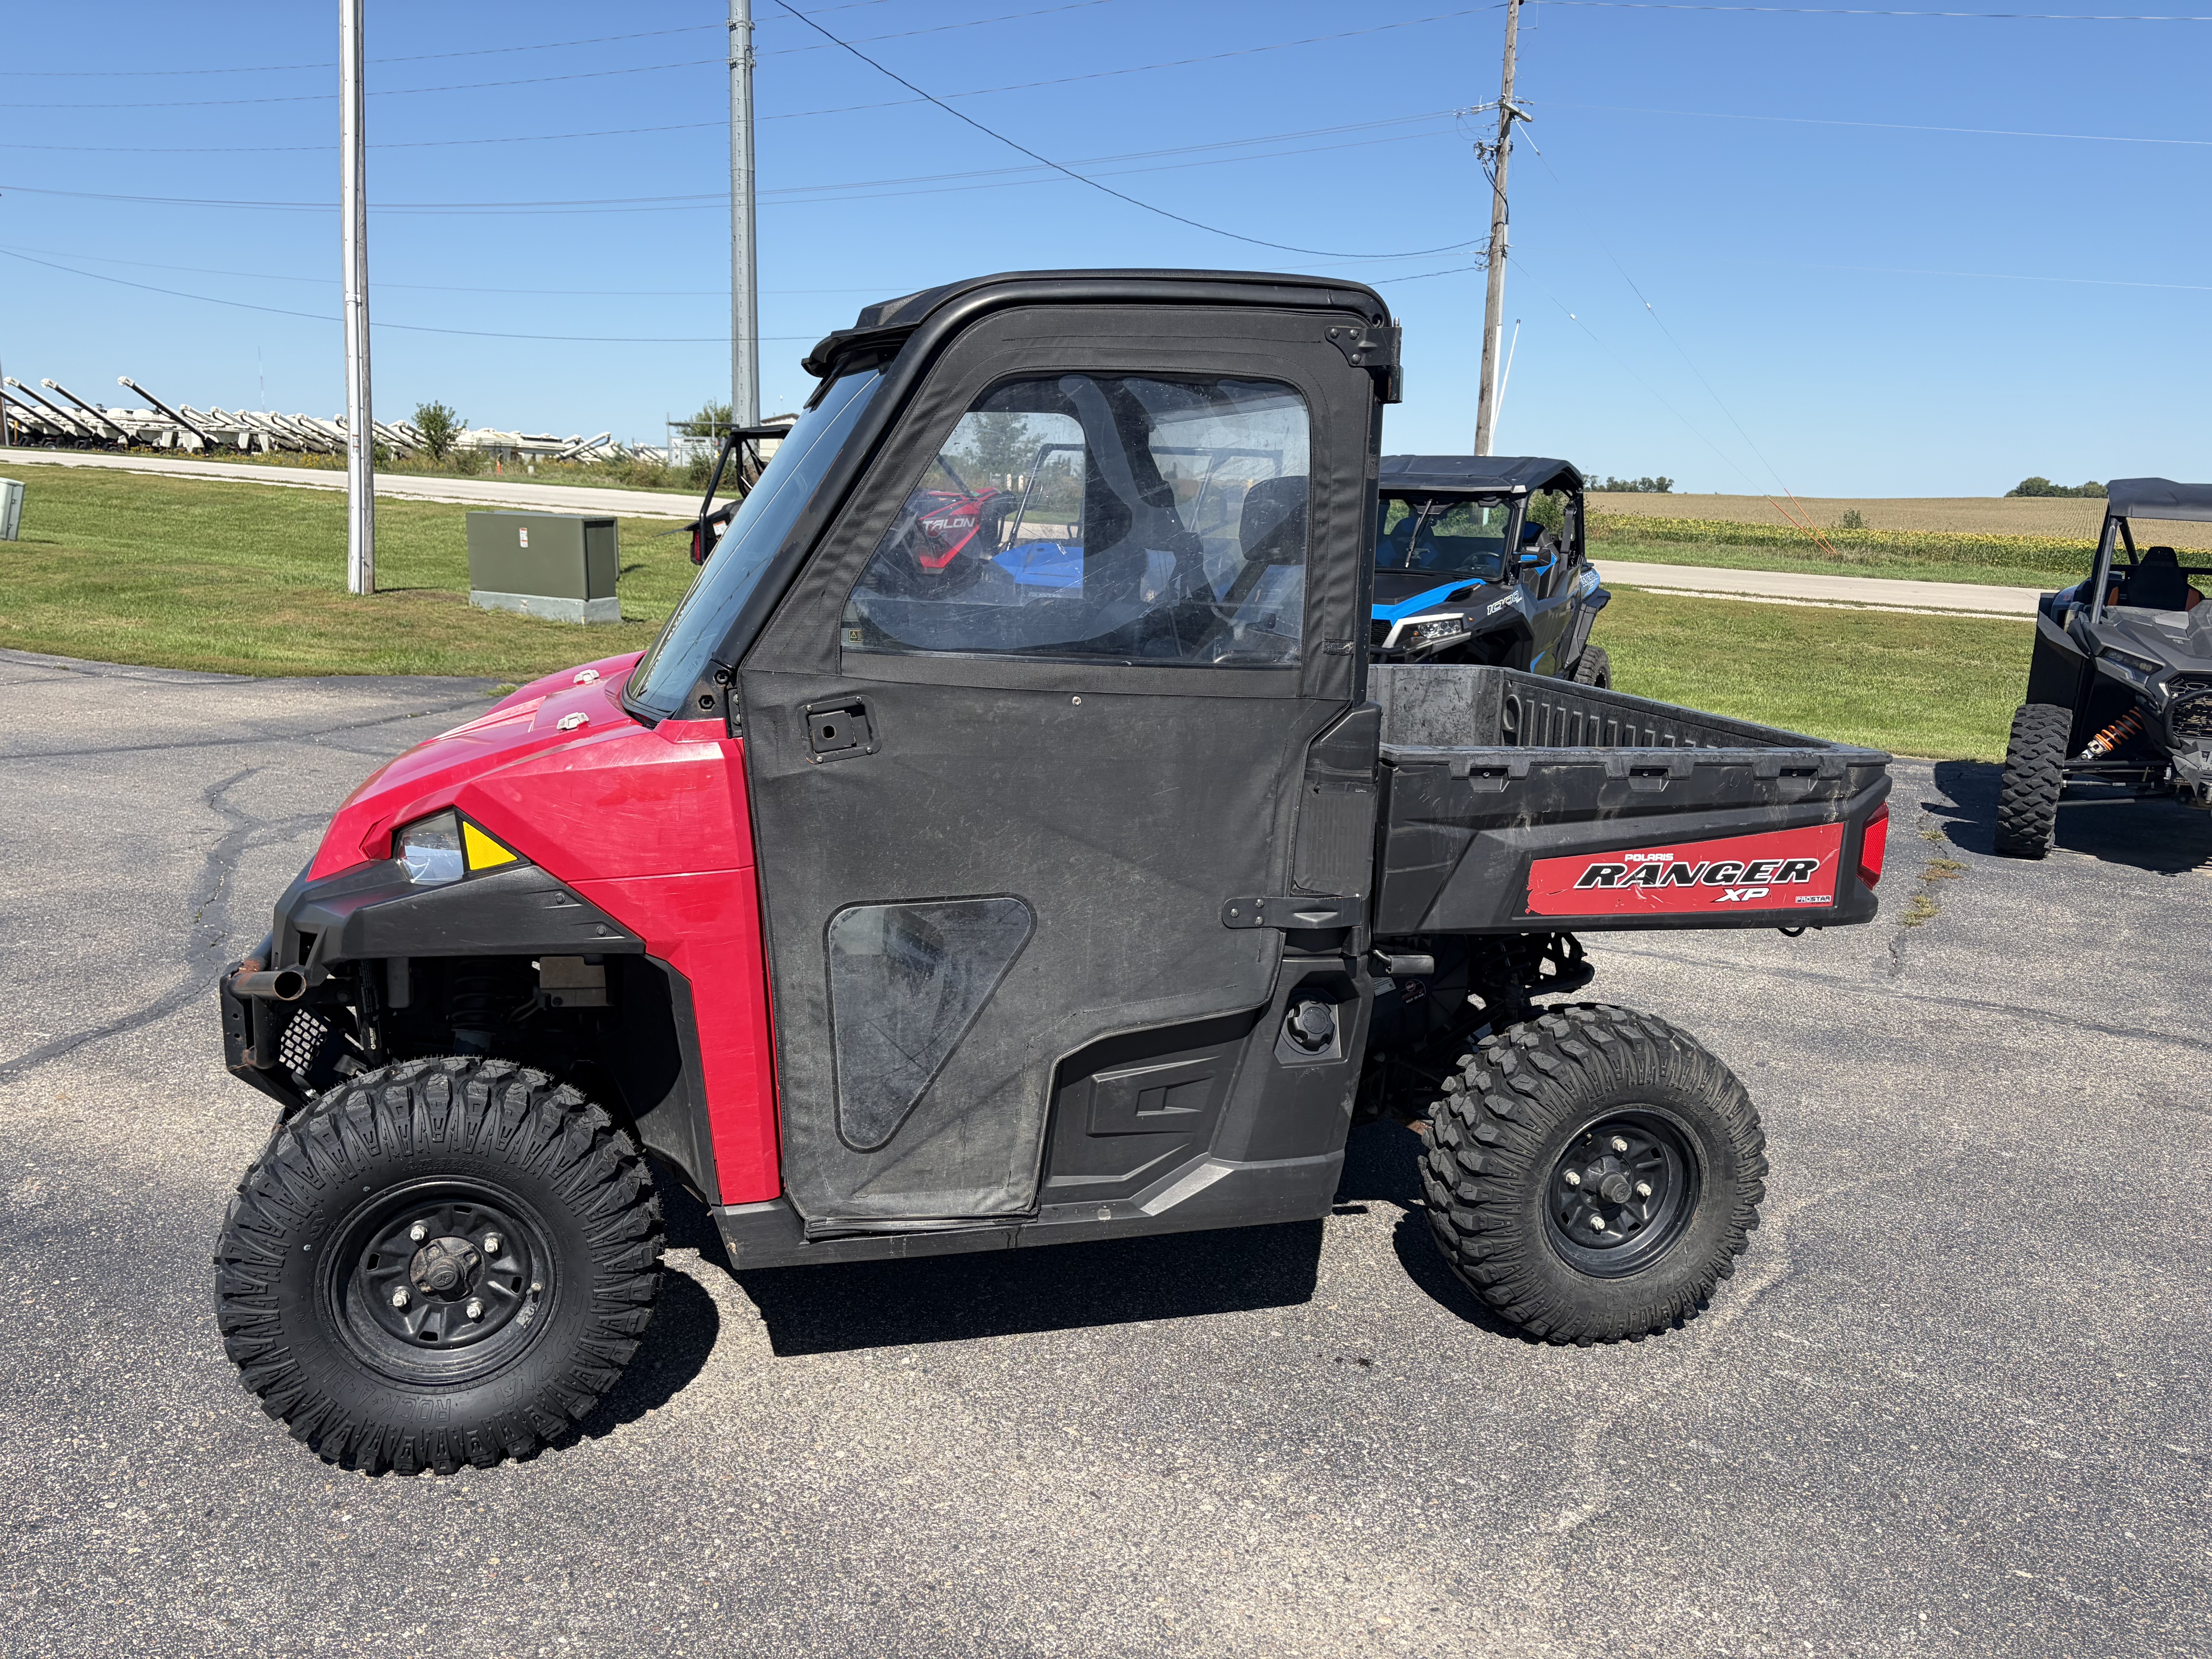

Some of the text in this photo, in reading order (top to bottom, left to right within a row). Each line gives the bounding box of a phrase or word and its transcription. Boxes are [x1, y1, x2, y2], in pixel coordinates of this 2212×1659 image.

[923, 517, 976, 531] TALON
[1487, 590, 1519, 615] 1000
[1625, 853, 1674, 862] POLARIS
[1573, 858, 1820, 889] RANGER
[1709, 888, 1770, 903] XP
[294, 1334, 354, 1395] BILLY
[378, 1394, 452, 1423] ROCK
